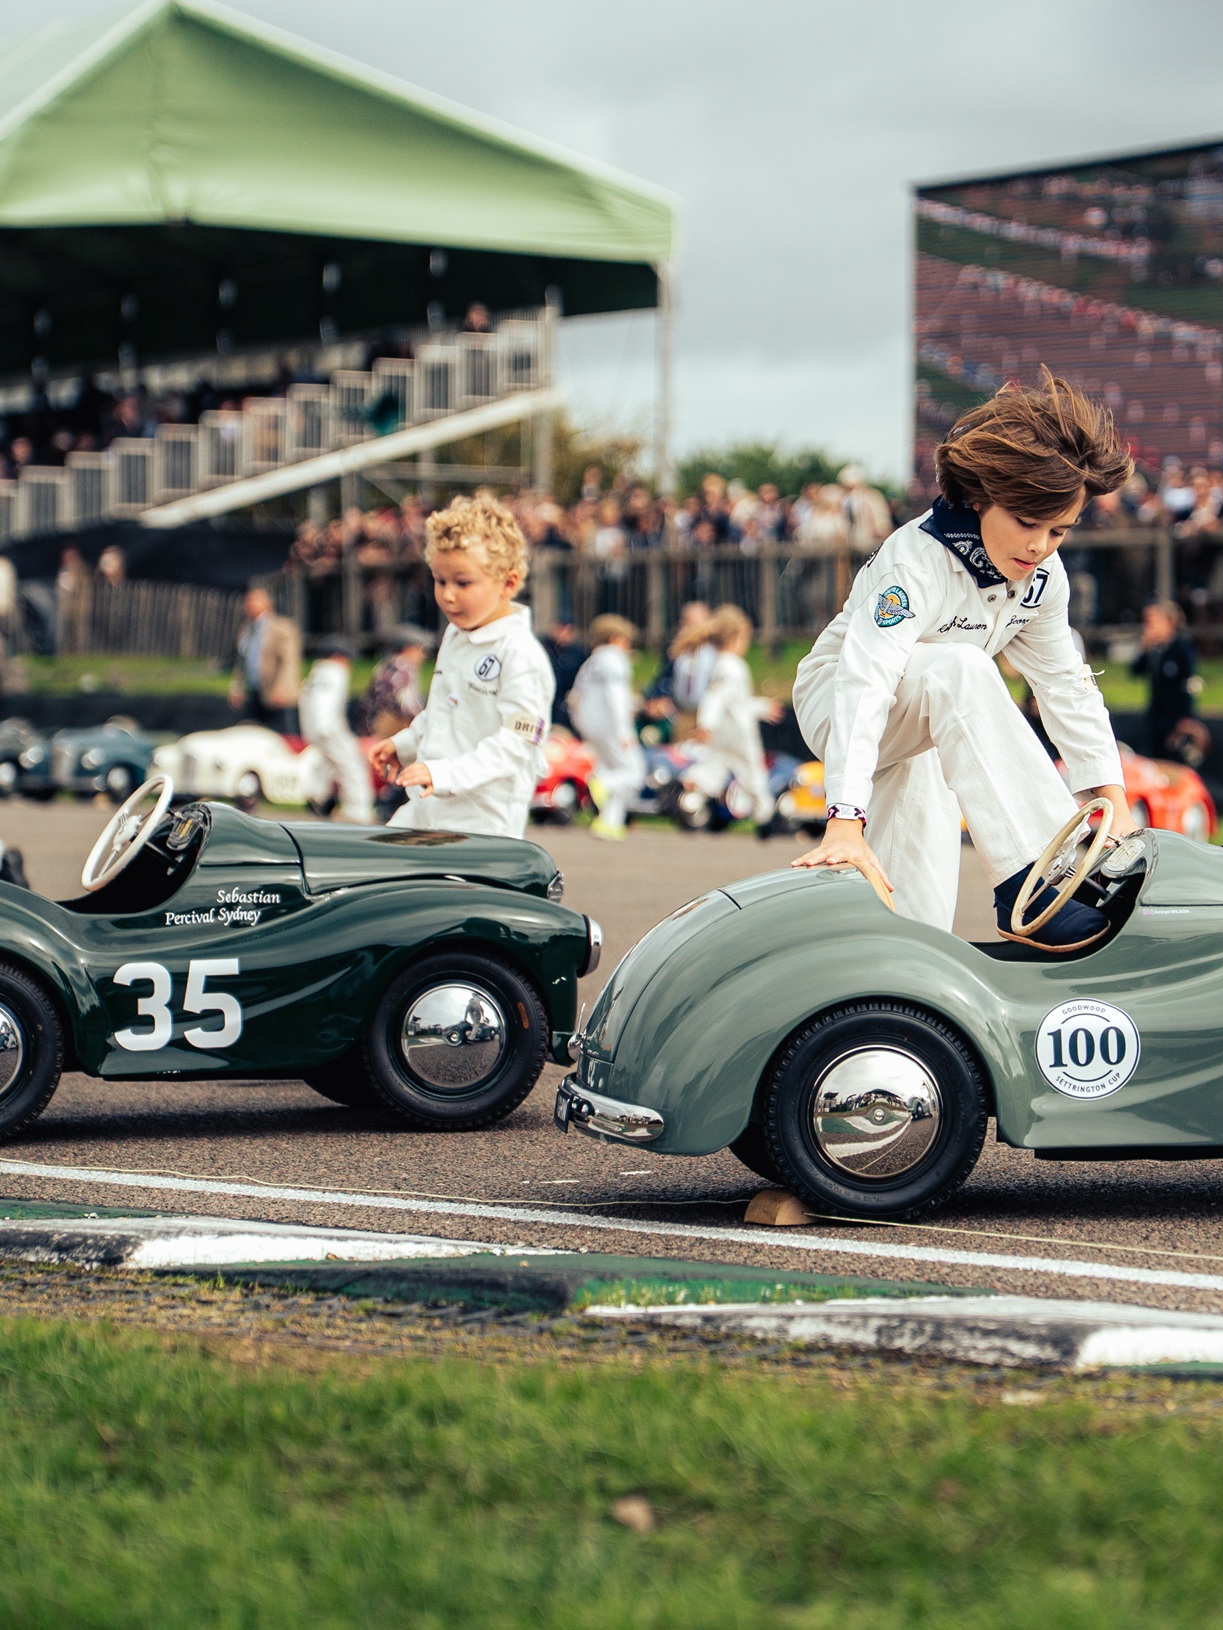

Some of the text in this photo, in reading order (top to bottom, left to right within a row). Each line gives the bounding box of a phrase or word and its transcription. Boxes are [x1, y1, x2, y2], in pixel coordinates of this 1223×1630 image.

[478, 656, 494, 678] 67
[216, 887, 281, 904] Sebastian
[164, 905, 261, 927] Percival Sydney
[112, 957, 243, 1052] 35
[1062, 1005, 1106, 1015] GOODWOOD
[1047, 1026, 1126, 1068] 100
[1055, 1072, 1121, 1093] SETTRINGTON CUP
